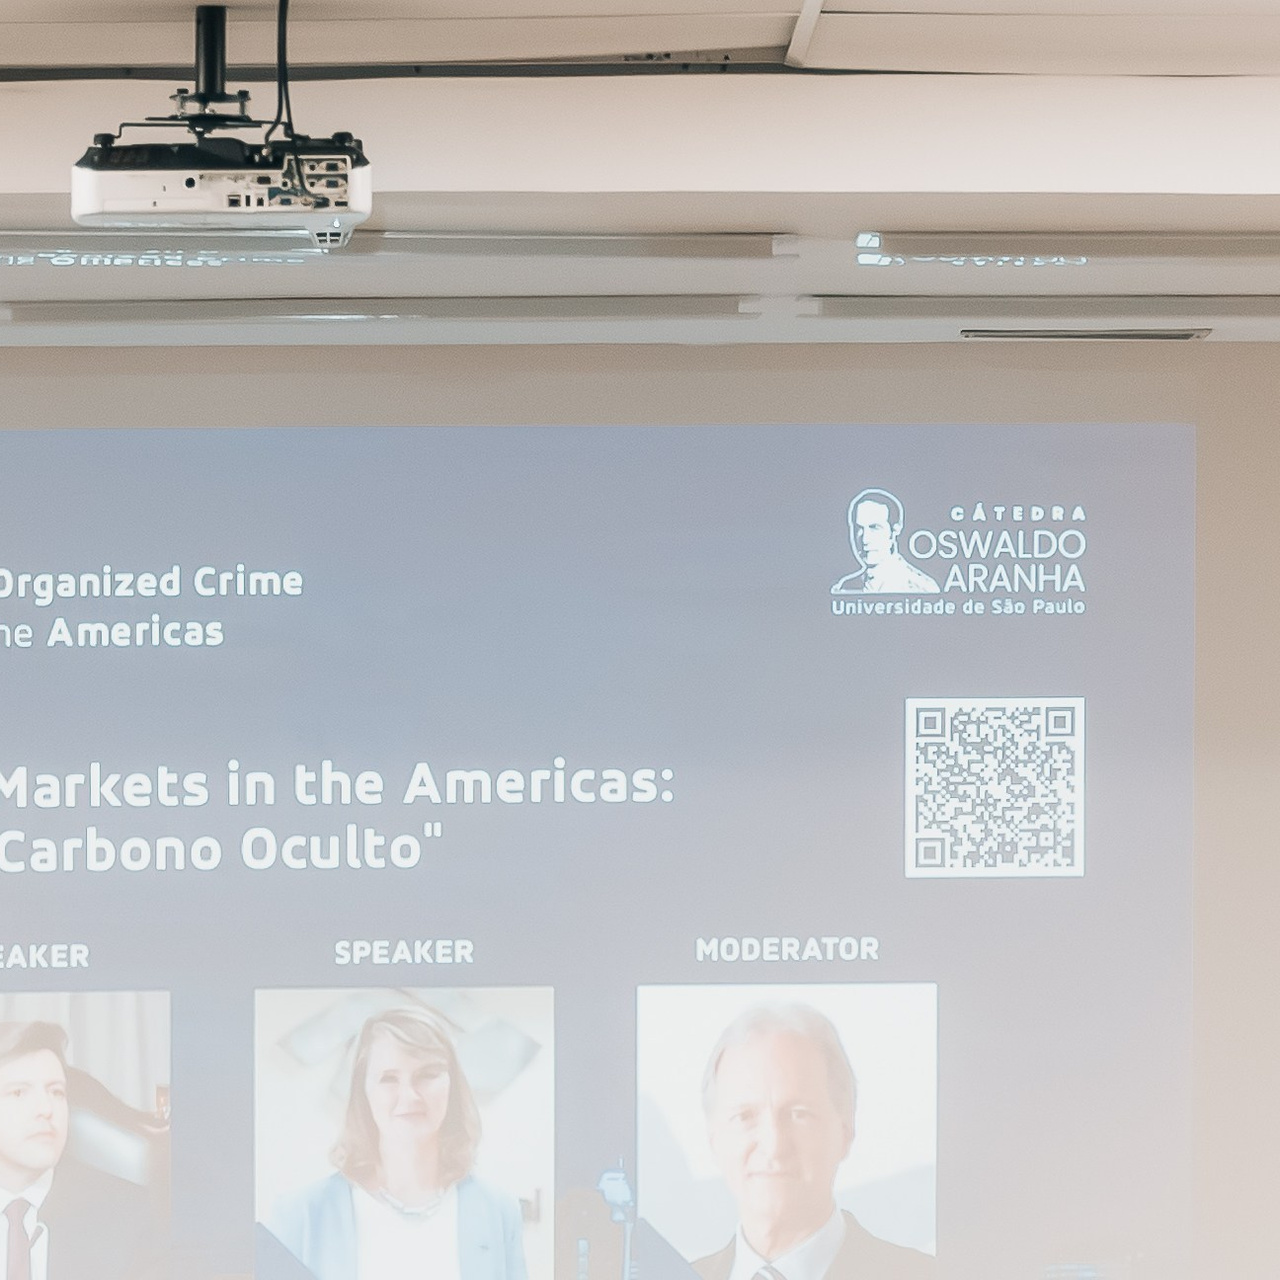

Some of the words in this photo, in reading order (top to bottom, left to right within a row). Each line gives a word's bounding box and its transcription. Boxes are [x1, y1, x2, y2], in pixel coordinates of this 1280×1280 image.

[950, 502, 1086, 522] CÁTEDRA
[909, 529, 1086, 559] OSWALDO
[194, 563, 303, 596] Crime
[943, 563, 1086, 593] ARANHA
[832, 598, 956, 615] Universidade
[962, 598, 985, 615] de
[991, 598, 1026, 614] São
[1032, 598, 1085, 614] Paulo
[47, 613, 224, 647] Americas
[227, 759, 275, 806] in
[295, 759, 384, 805] the
[402, 756, 673, 804] Americas:
[241, 822, 442, 870] Oculto"
[335, 939, 474, 965] SPEAKER
[696, 936, 879, 962] MODERATOR
